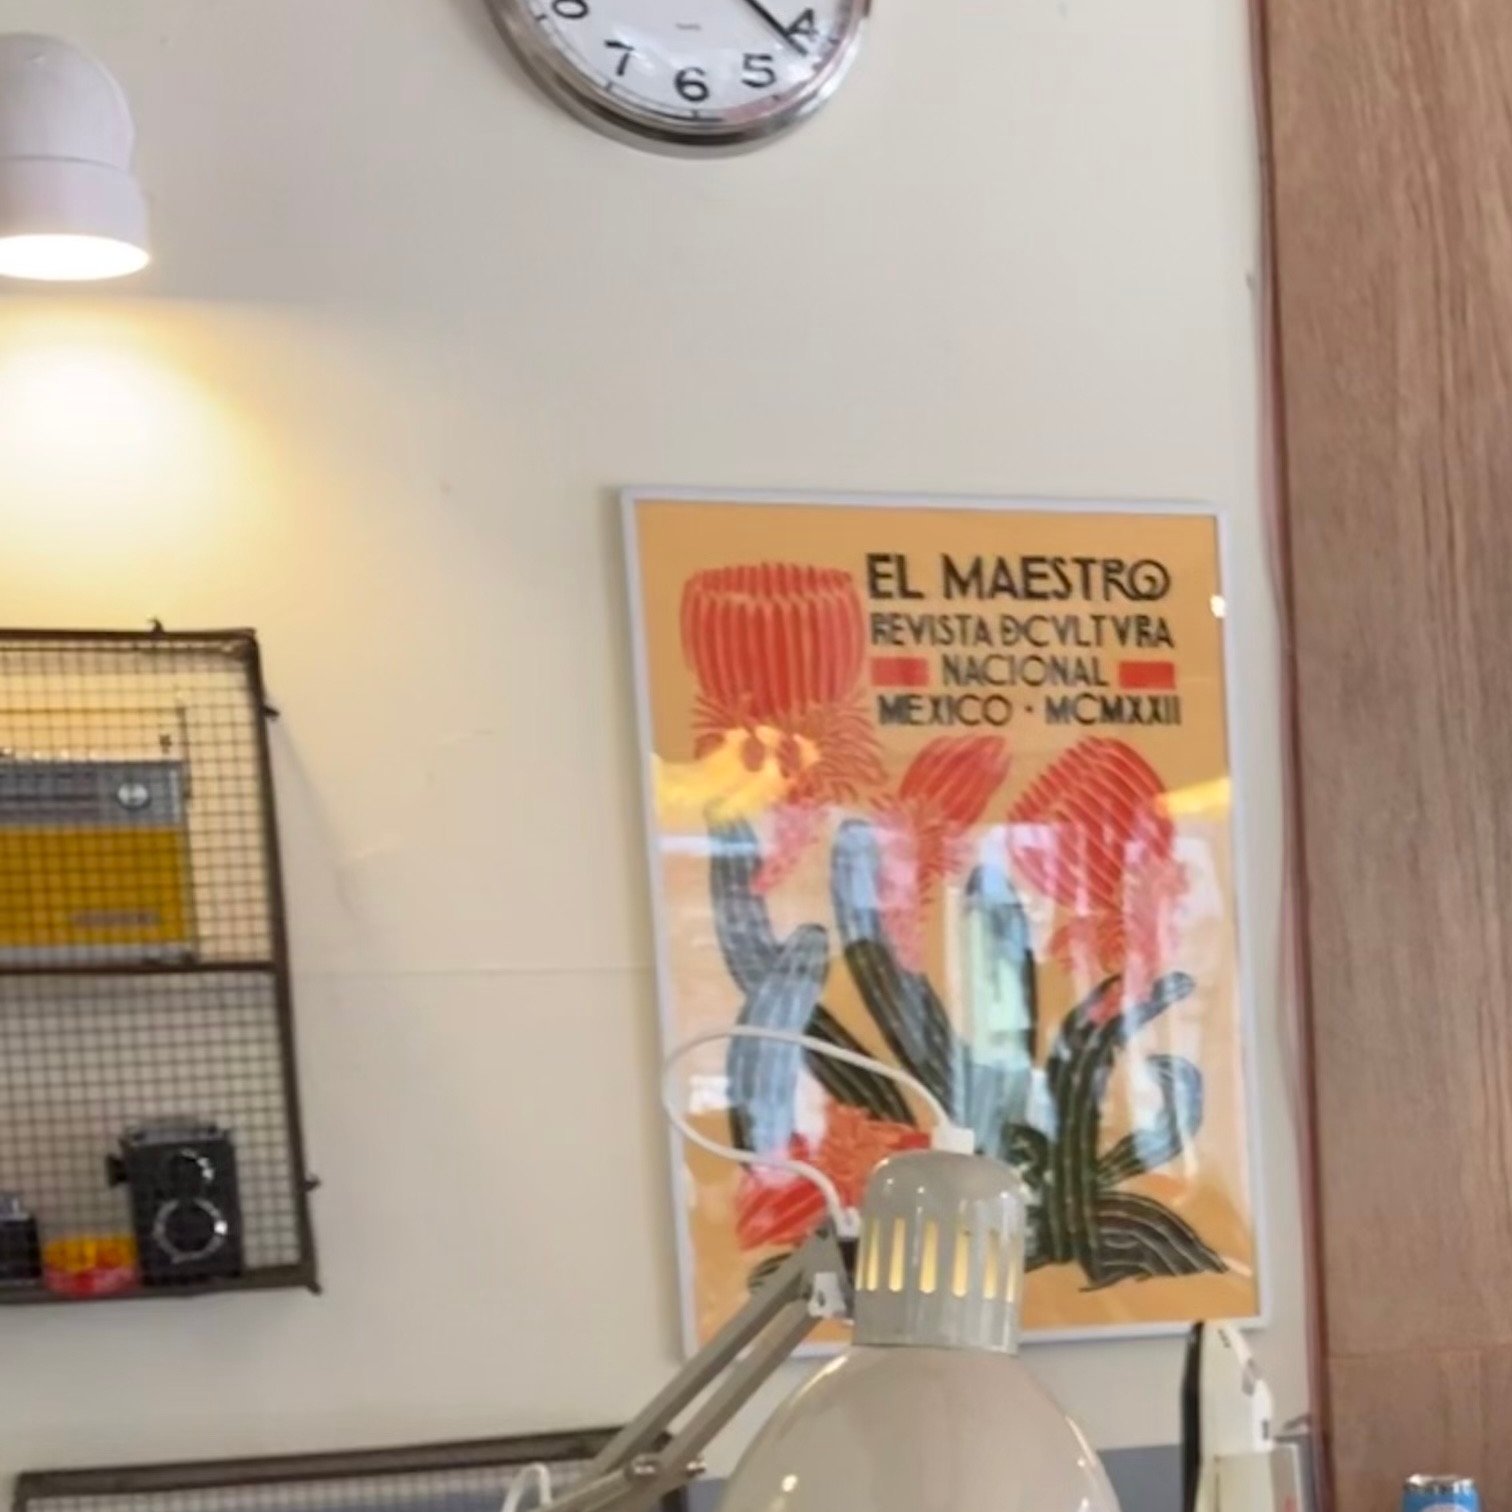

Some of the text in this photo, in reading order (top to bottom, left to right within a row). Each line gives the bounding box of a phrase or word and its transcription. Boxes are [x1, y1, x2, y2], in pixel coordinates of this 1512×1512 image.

[604, 40, 634, 76] 7
[741, 53, 777, 88] 5
[674, 66, 710, 102] 6
[866, 553, 1171, 602] EL MAESTRO
[870, 612, 994, 647] REVISTA
[942, 653, 1109, 687] NACIONAL
[877, 692, 1182, 727] MEXICO MCMXXII
